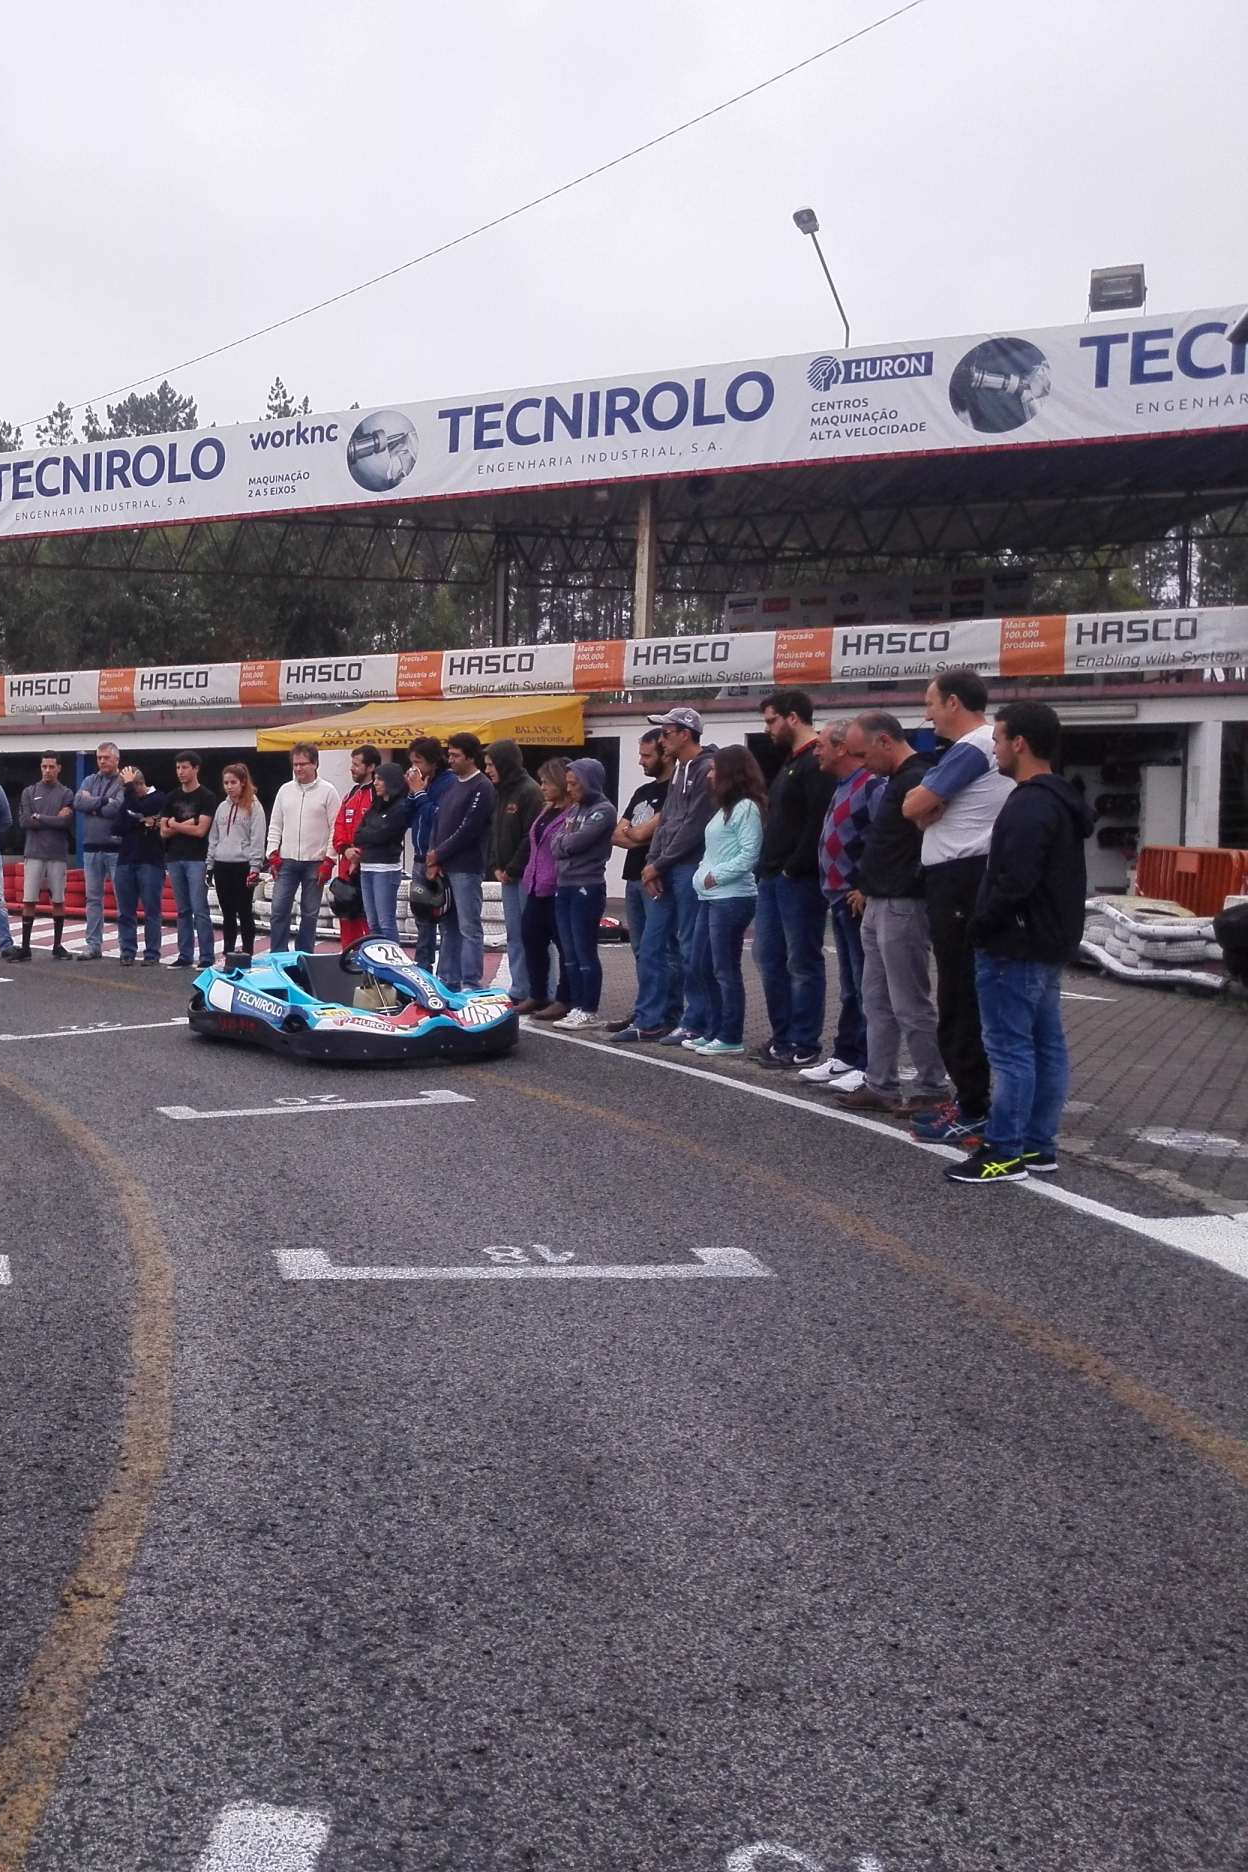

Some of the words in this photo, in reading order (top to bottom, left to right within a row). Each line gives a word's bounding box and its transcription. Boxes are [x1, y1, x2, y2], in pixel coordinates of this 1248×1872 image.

[850, 355, 926, 380] HURON
[438, 370, 775, 454] TECNIROLO
[811, 398, 869, 413] CENTROS
[810, 407, 899, 427] MAQUINAÇÃO
[809, 426, 842, 441] ALTA
[845, 421, 927, 438] VELOCIDADE
[477, 455, 573, 475] ENGENHARIA
[581, 446, 683, 464] INDUSTRIAL,
[248, 469, 310, 486] MAQUINAÇÃO
[248, 489, 253, 498] 2
[255, 489, 262, 497] A
[263, 488, 268, 496] 5
[270, 485, 296, 496] EIXOS
[15, 506, 85, 521] ENGENHARIA
[90, 500, 162, 513] INDUSTRIAL,
[1005, 621, 1027, 629] Mais
[1028, 620, 1040, 628] de
[1076, 617, 1198, 645] HASCO
[841, 630, 950, 656] HASCO
[633, 642, 730, 666] HASCO
[813, 650, 825, 658] de
[1075, 655, 1141, 668] Enabling
[1145, 652, 1175, 665] with
[1180, 650, 1242, 664] System.
[286, 663, 362, 684] HASCO
[449, 653, 534, 676] HASCO
[840, 665, 899, 677] Enabling
[903, 663, 930, 674] with
[9, 678, 71, 697] HASCO
[140, 671, 208, 690] HASCO
[449, 683, 495, 694] Enabling
[498, 681, 521, 691] with
[632, 674, 684, 686] Enabling
[687, 672, 712, 683] with
[716, 670, 766, 683] System.
[179, 696, 197, 705] with
[286, 691, 327, 700] Enabling
[329, 690, 349, 698] with
[378, 945, 403, 964] 24
[236, 989, 283, 1017] TECNIROLO
[353, 1018, 393, 1032] HURON
[481, 1243, 577, 1265] 18
